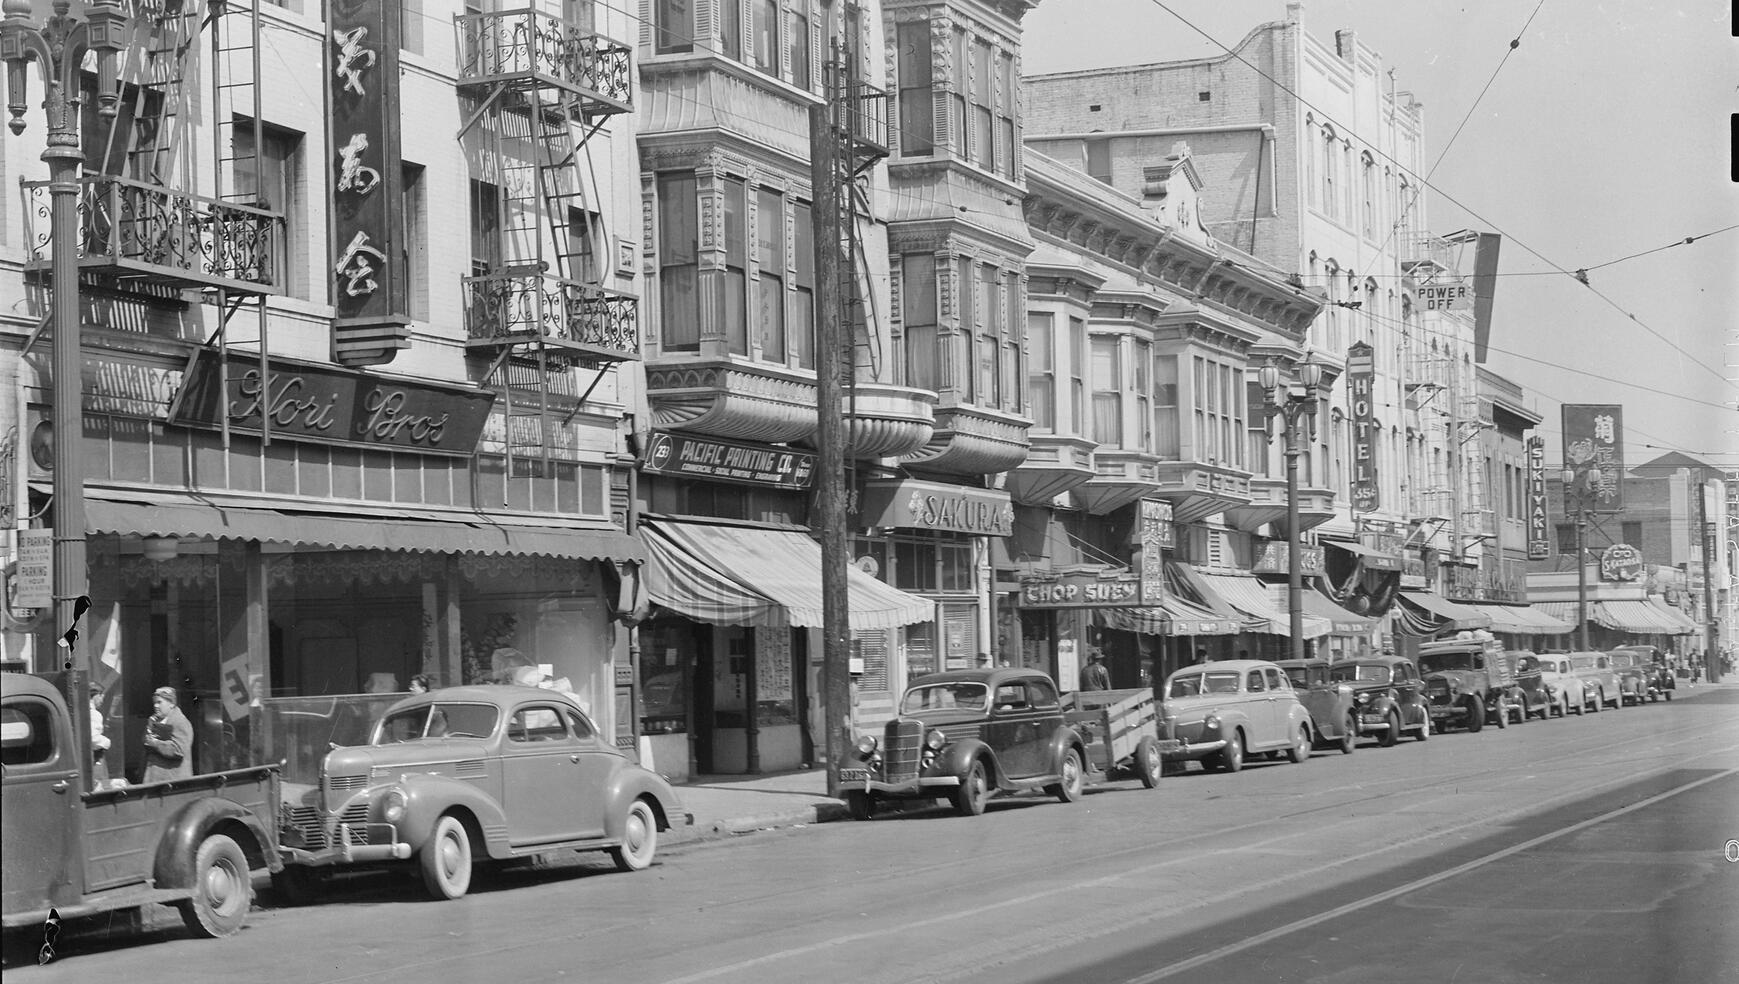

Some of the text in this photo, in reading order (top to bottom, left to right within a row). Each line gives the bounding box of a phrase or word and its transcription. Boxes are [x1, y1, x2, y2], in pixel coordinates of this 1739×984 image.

[1418, 286, 1465, 299] POWER
[1427, 298, 1454, 310] OFF
[1354, 378, 1371, 482] HOTEL
[679, 440, 725, 465] PACIFIC
[723, 446, 777, 472] PRINTING
[1532, 447, 1546, 540] SUKIYAKI
[924, 495, 1001, 531] SAKURA
[27, 535, 50, 548] PARKING
[22, 566, 48, 577] PARKING
[1026, 583, 1137, 601] CHOP SUEY
